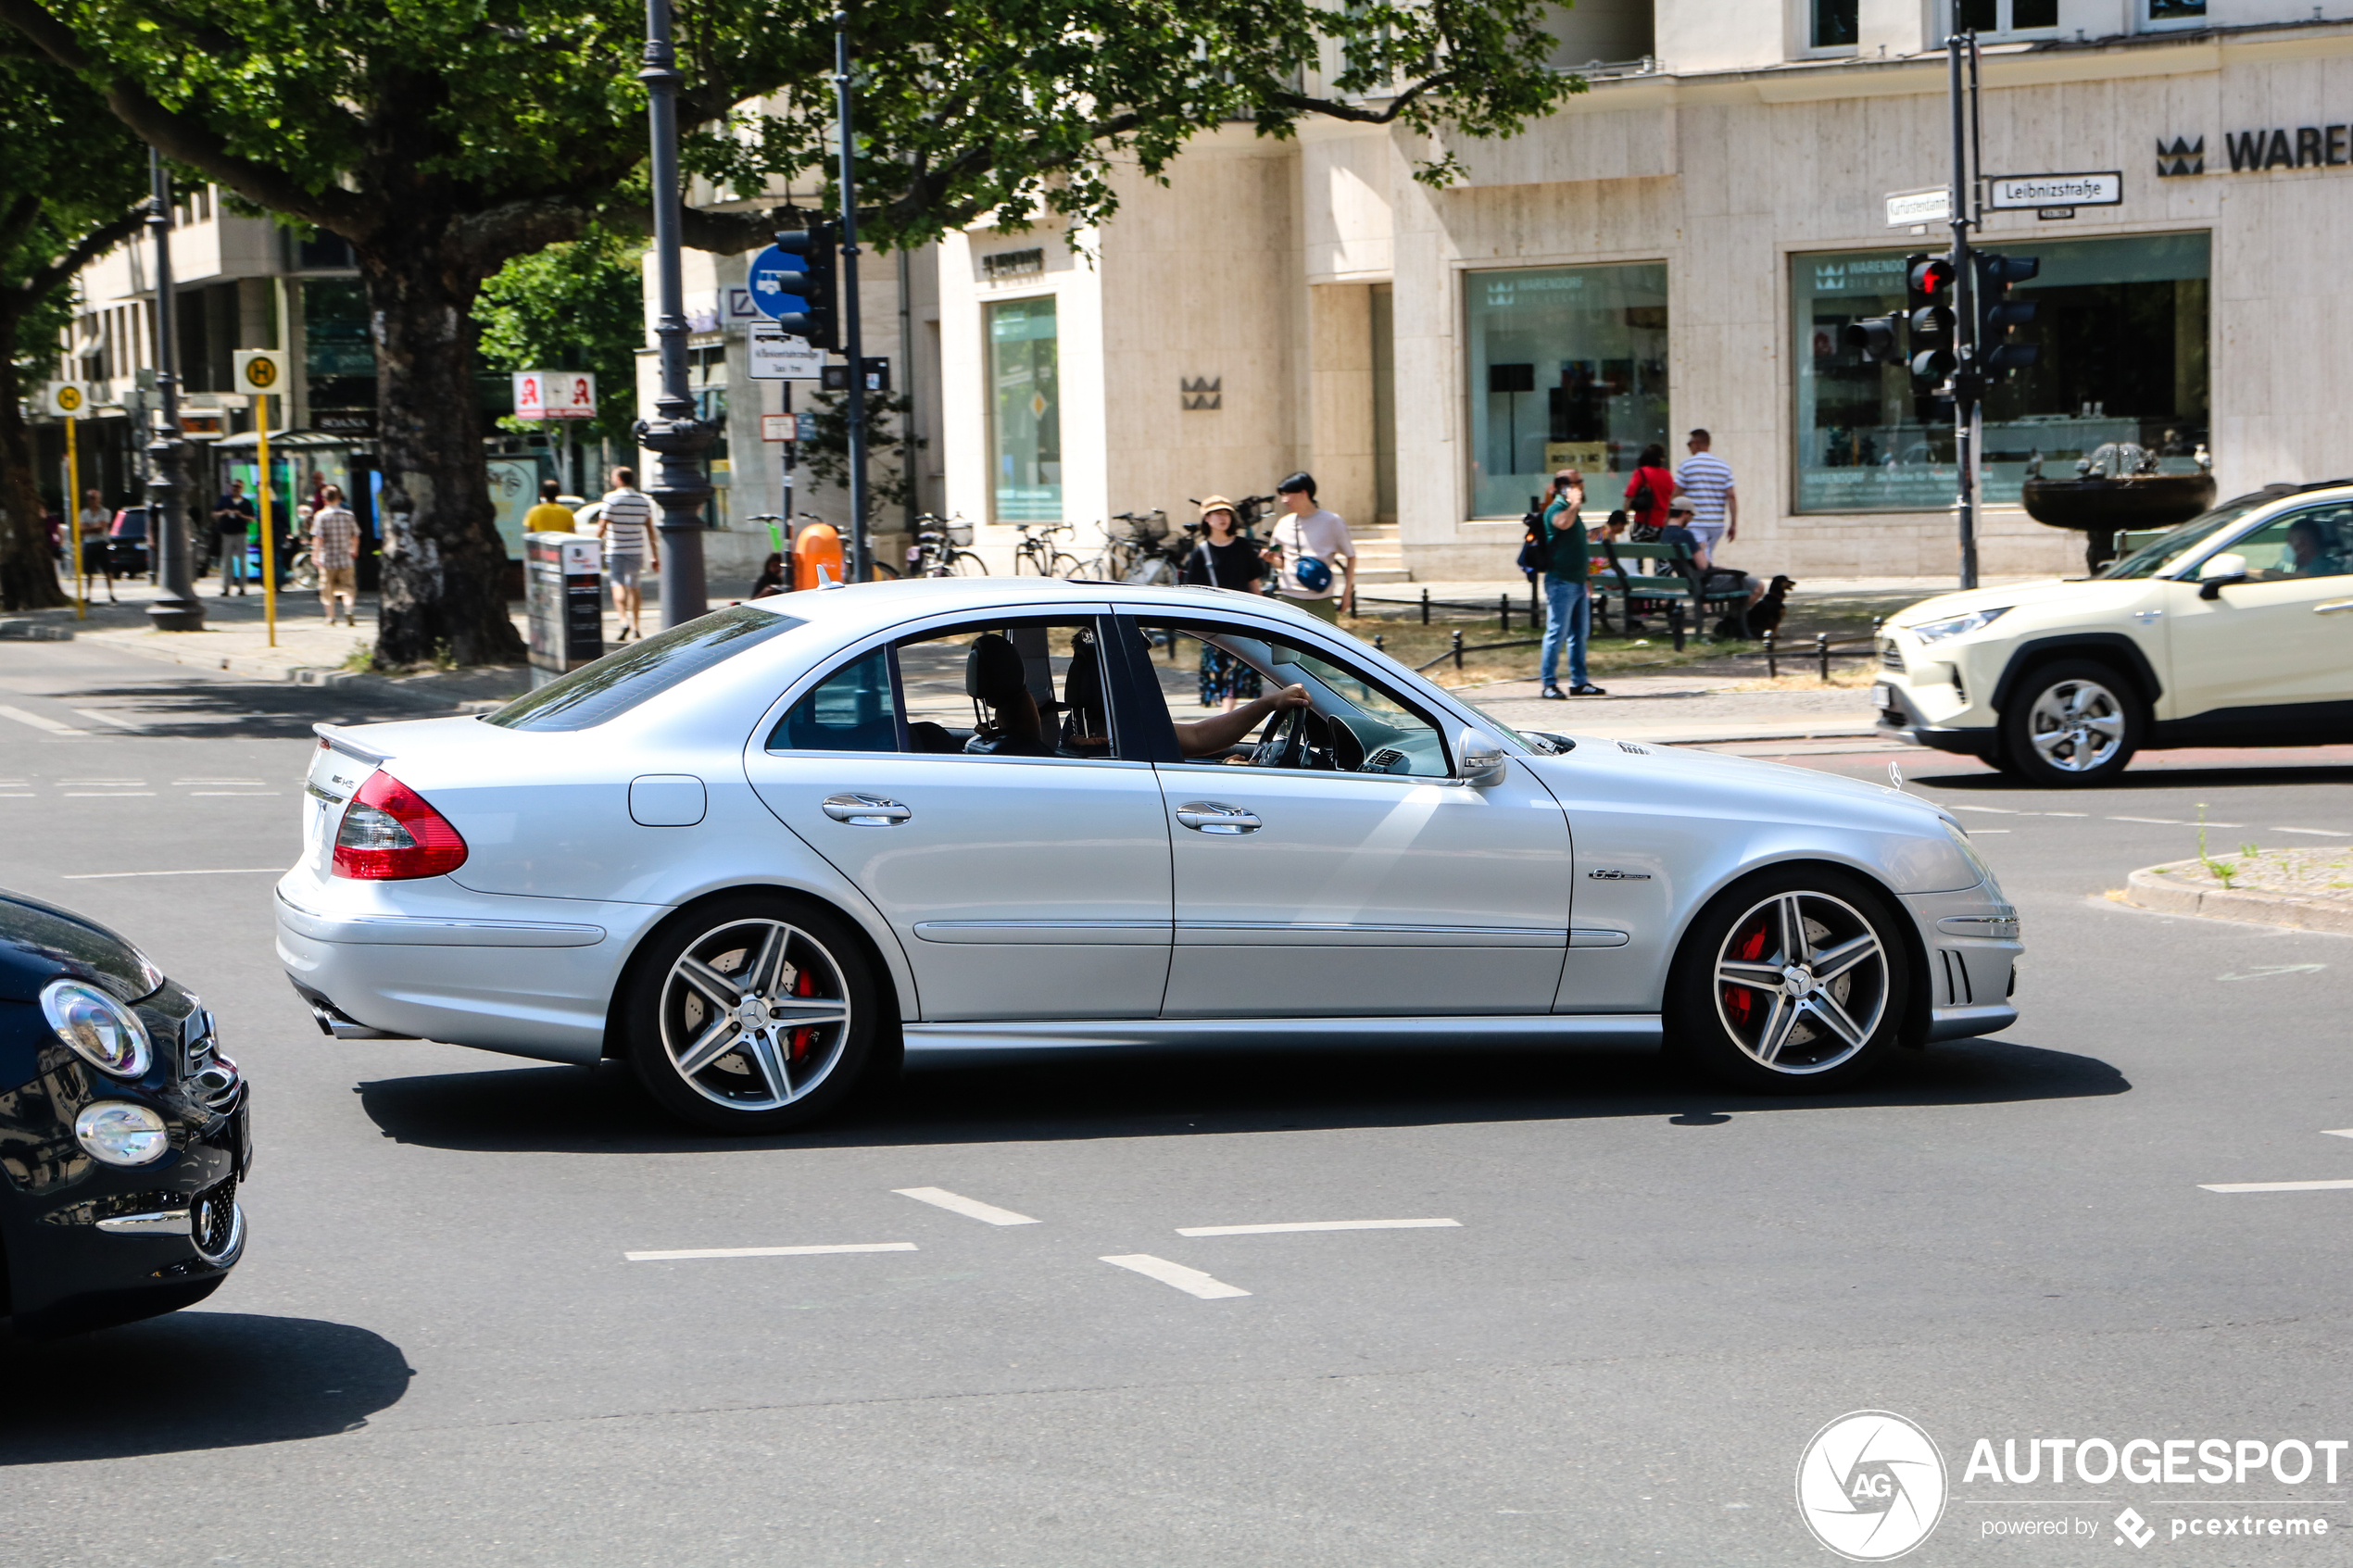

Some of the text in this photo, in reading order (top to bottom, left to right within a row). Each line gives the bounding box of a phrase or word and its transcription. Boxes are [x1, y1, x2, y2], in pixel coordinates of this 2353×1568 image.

[2225, 124, 2353, 172] WARE
[2006, 179, 2102, 200] Leibnizstraße
[1847, 259, 1907, 274] WARENDO
[1593, 868, 1624, 880] 6.3
